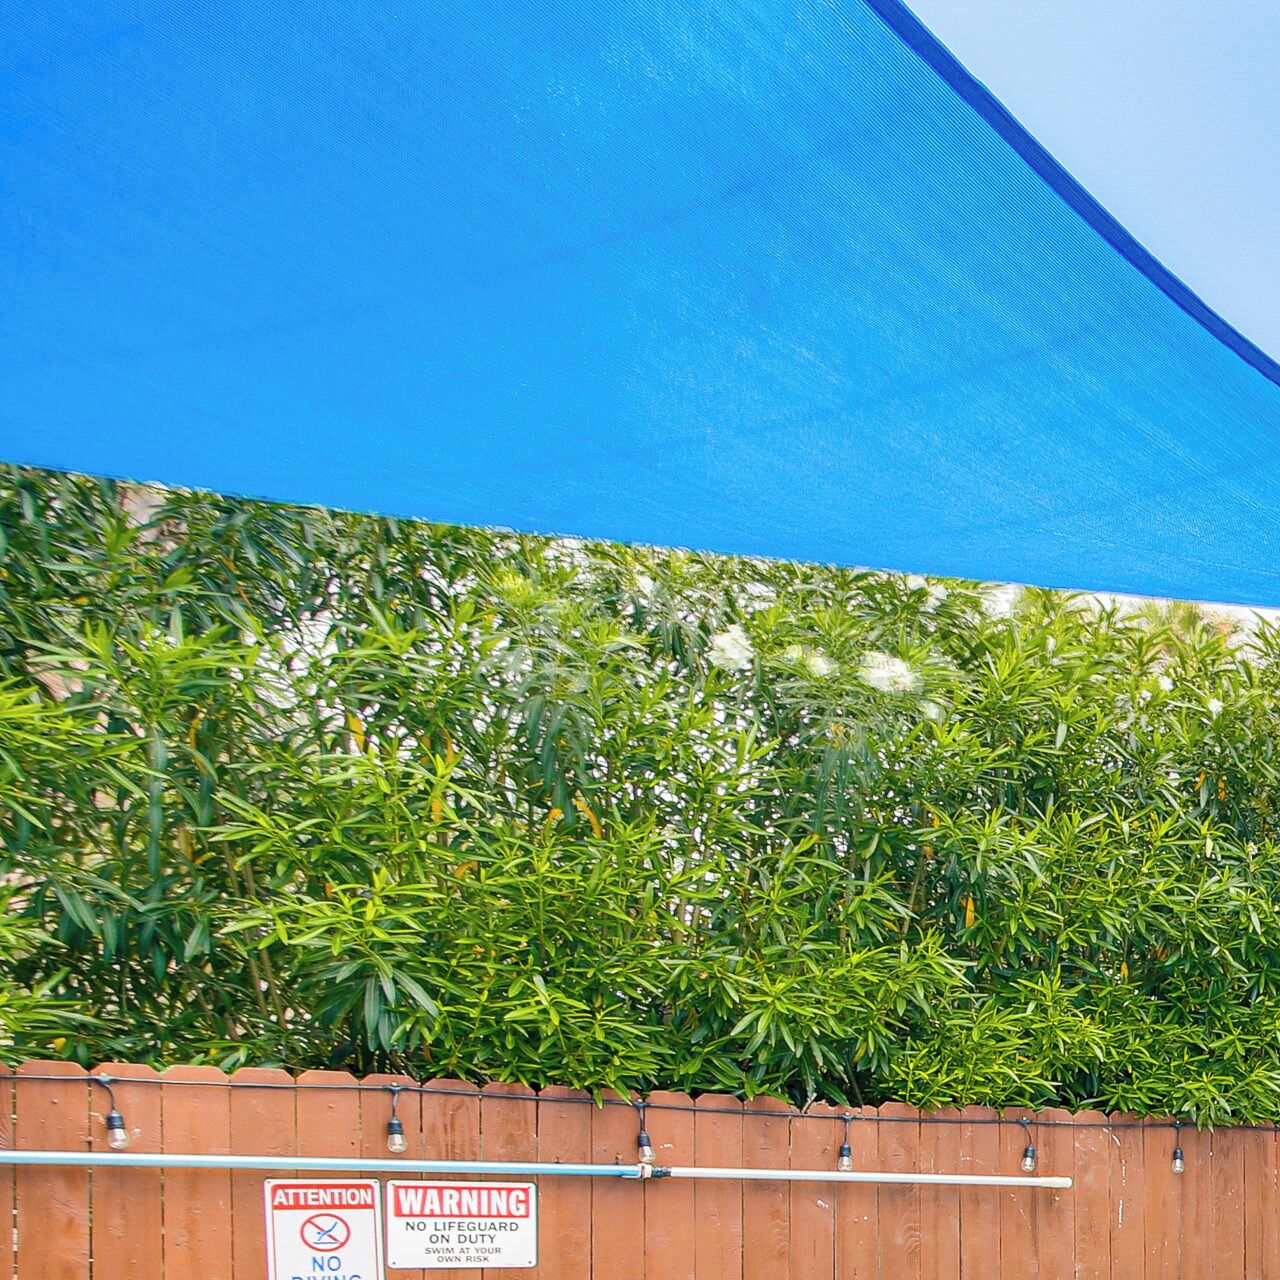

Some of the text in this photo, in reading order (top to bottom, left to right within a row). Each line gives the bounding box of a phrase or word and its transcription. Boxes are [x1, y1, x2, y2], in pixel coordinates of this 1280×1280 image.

[273, 1188, 372, 1206] ATTENTION
[397, 1188, 526, 1216] WARNING
[405, 1221, 519, 1232] NO LIFEGUARD
[429, 1234, 497, 1244] ON DUTY
[312, 1256, 341, 1272] NO
[437, 1255, 490, 1263] OWN RISK
